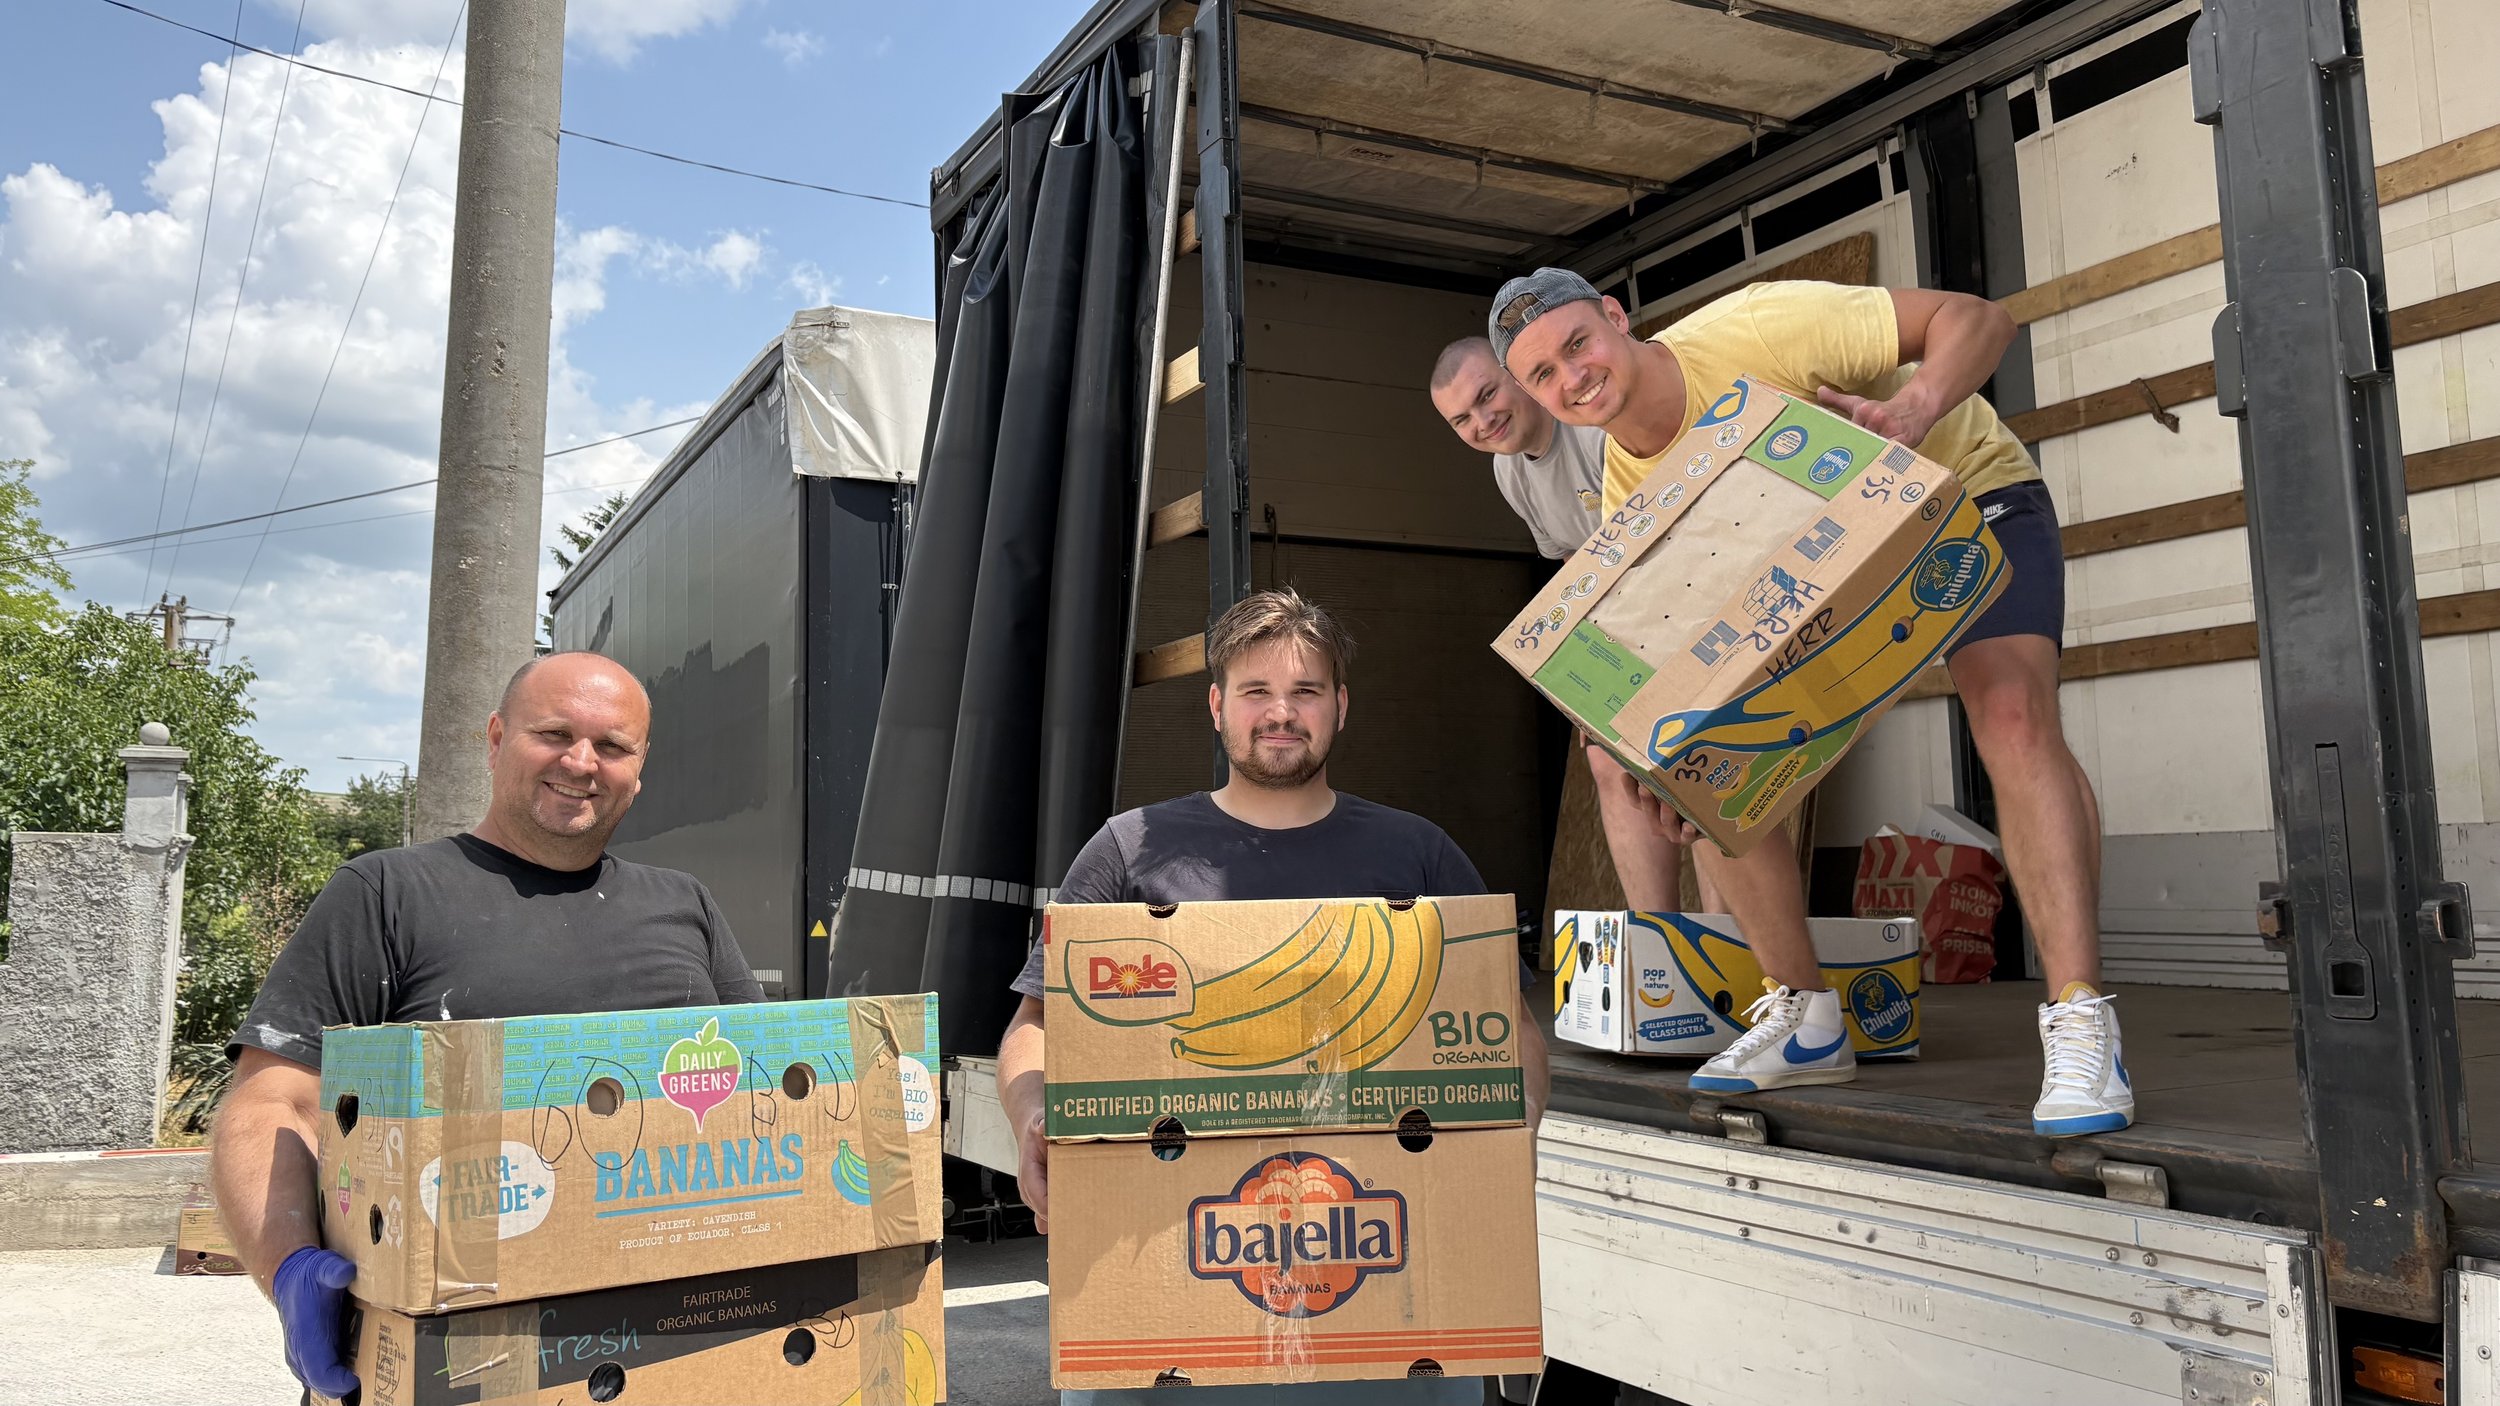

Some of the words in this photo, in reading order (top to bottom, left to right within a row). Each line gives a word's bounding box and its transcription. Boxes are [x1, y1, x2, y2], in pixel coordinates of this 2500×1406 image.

[1983, 503, 2004, 517] NIKE
[1584, 493, 1658, 556] HERR
[1939, 543, 1981, 609] Chiquita
[1765, 607, 1838, 685] HERR
[1706, 758, 1730, 785] pop
[1715, 764, 1740, 790] nature
[1746, 788, 1772, 817] ORGANIC
[1770, 759, 1795, 788] BANANA
[1750, 788, 1778, 822] SELECTED
[1776, 759, 1800, 789] QUALITY
[1855, 884, 1915, 909] MAXI
[1943, 939, 1992, 955] PRISER
[1089, 954, 1177, 994] Dole
[1643, 969, 1666, 981] pop
[1428, 1010, 1511, 1048] BIO
[1645, 1020, 1676, 1029] SELECTED
[1677, 1017, 1704, 1025] QUALITY
[1860, 1000, 1911, 1036] Chiquita
[1649, 1028, 1676, 1039] CLASS
[1677, 1025, 1705, 1035] EXTRA
[680, 1052, 722, 1072] DAILY
[1432, 1050, 1511, 1065] ORGANIC
[669, 1072, 732, 1095] GREENS
[887, 1068, 917, 1083] Yes!
[905, 1089, 928, 1103] BIO
[1064, 1096, 1154, 1118] CERTIFIED
[1160, 1092, 1240, 1114] ORGANIC
[1246, 1088, 1333, 1111] BANANAS
[1351, 1085, 1439, 1107] CERTIFIED
[1444, 1083, 1520, 1104] ORGANIC
[869, 1107, 924, 1121] organic
[1231, 1117, 1266, 1125] REGISTERED
[1267, 1116, 1303, 1124] TRADEMARK
[453, 1155, 519, 1190] FAIR-
[594, 1133, 804, 1202] BANANAS
[448, 1183, 529, 1223] TRADE
[648, 1219, 696, 1232] VARIETY:
[703, 1211, 757, 1225] CAVENDISH
[619, 1235, 663, 1250] PRODUCT
[669, 1234, 682, 1244] OF
[688, 1228, 735, 1242] ECUADOR,
[741, 1222, 771, 1235] CLASS
[1205, 1206, 1395, 1276] bajella
[683, 1285, 752, 1308] FAIRTRADE
[1269, 1283, 1331, 1295] BANANAS
[657, 1311, 715, 1333] ORGANIC
[718, 1300, 777, 1321] BANANAS
